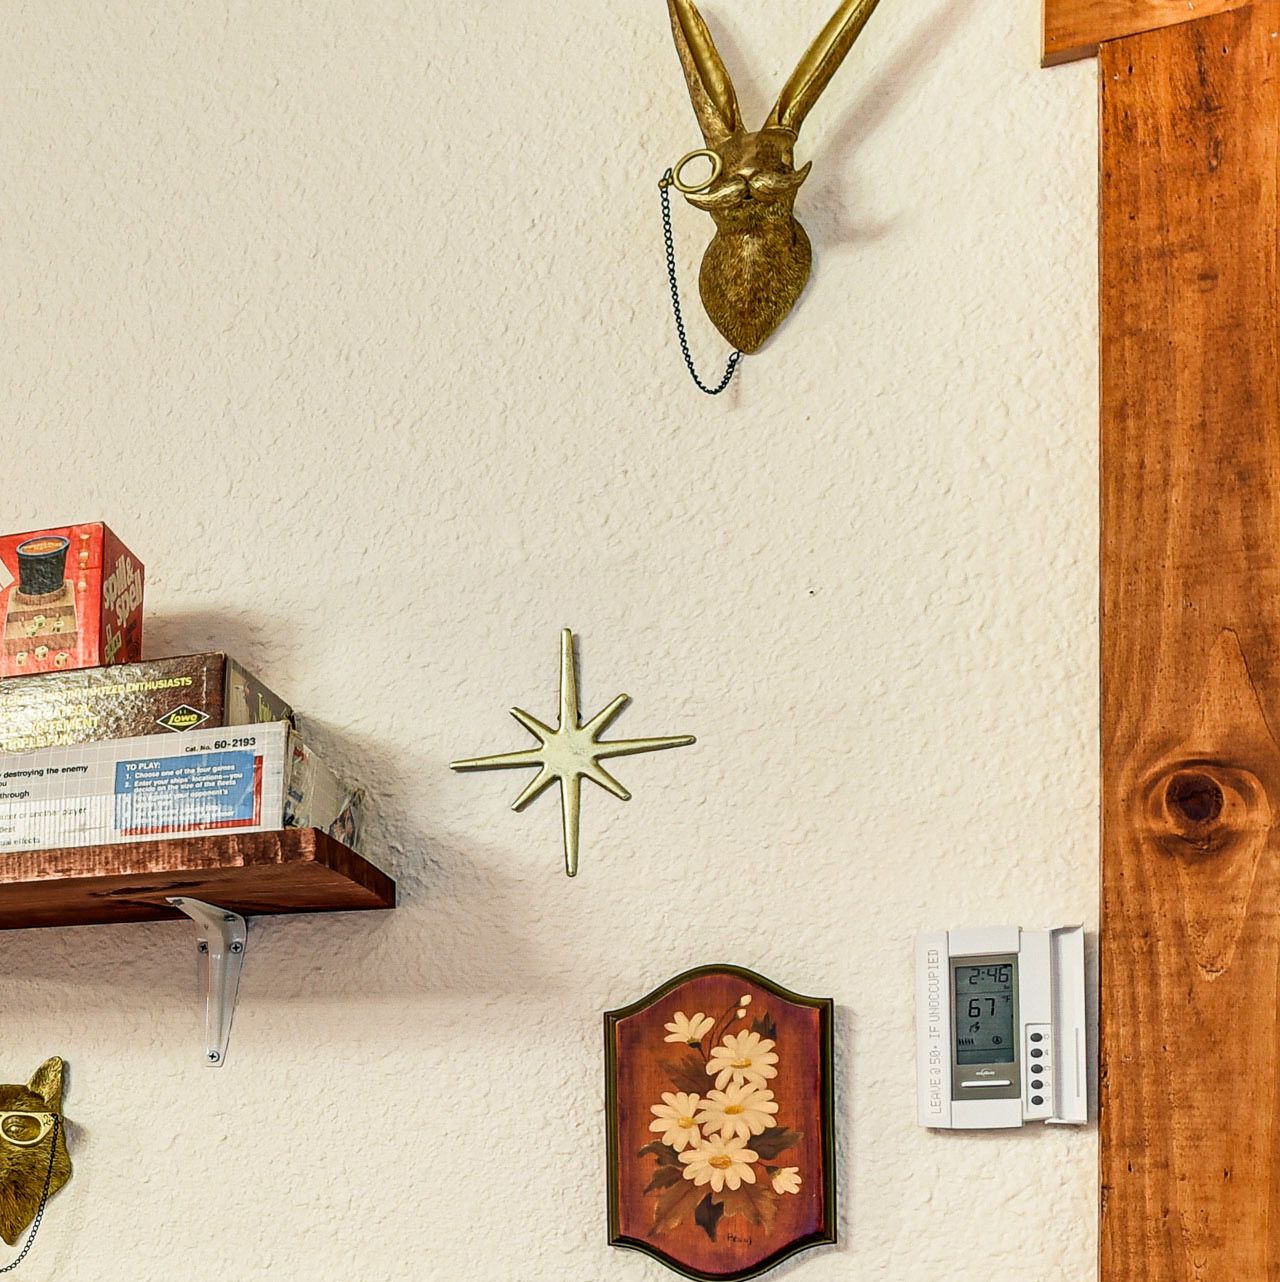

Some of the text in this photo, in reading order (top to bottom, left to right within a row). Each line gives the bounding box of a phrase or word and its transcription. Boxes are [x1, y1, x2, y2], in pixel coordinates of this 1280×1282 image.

[214, 737, 256, 750] 60-2193
[3, 768, 44, 781] destroying
[46, 767, 58, 775] the
[62, 765, 88, 776] enemy
[0, 790, 29, 801] through
[969, 966, 1009, 985] 2:46
[928, 949, 941, 1022] UNOCCUPIED
[969, 998, 995, 1018] 67
[929, 1025, 940, 1038] IF
[930, 1079, 942, 1113] LEAVE
